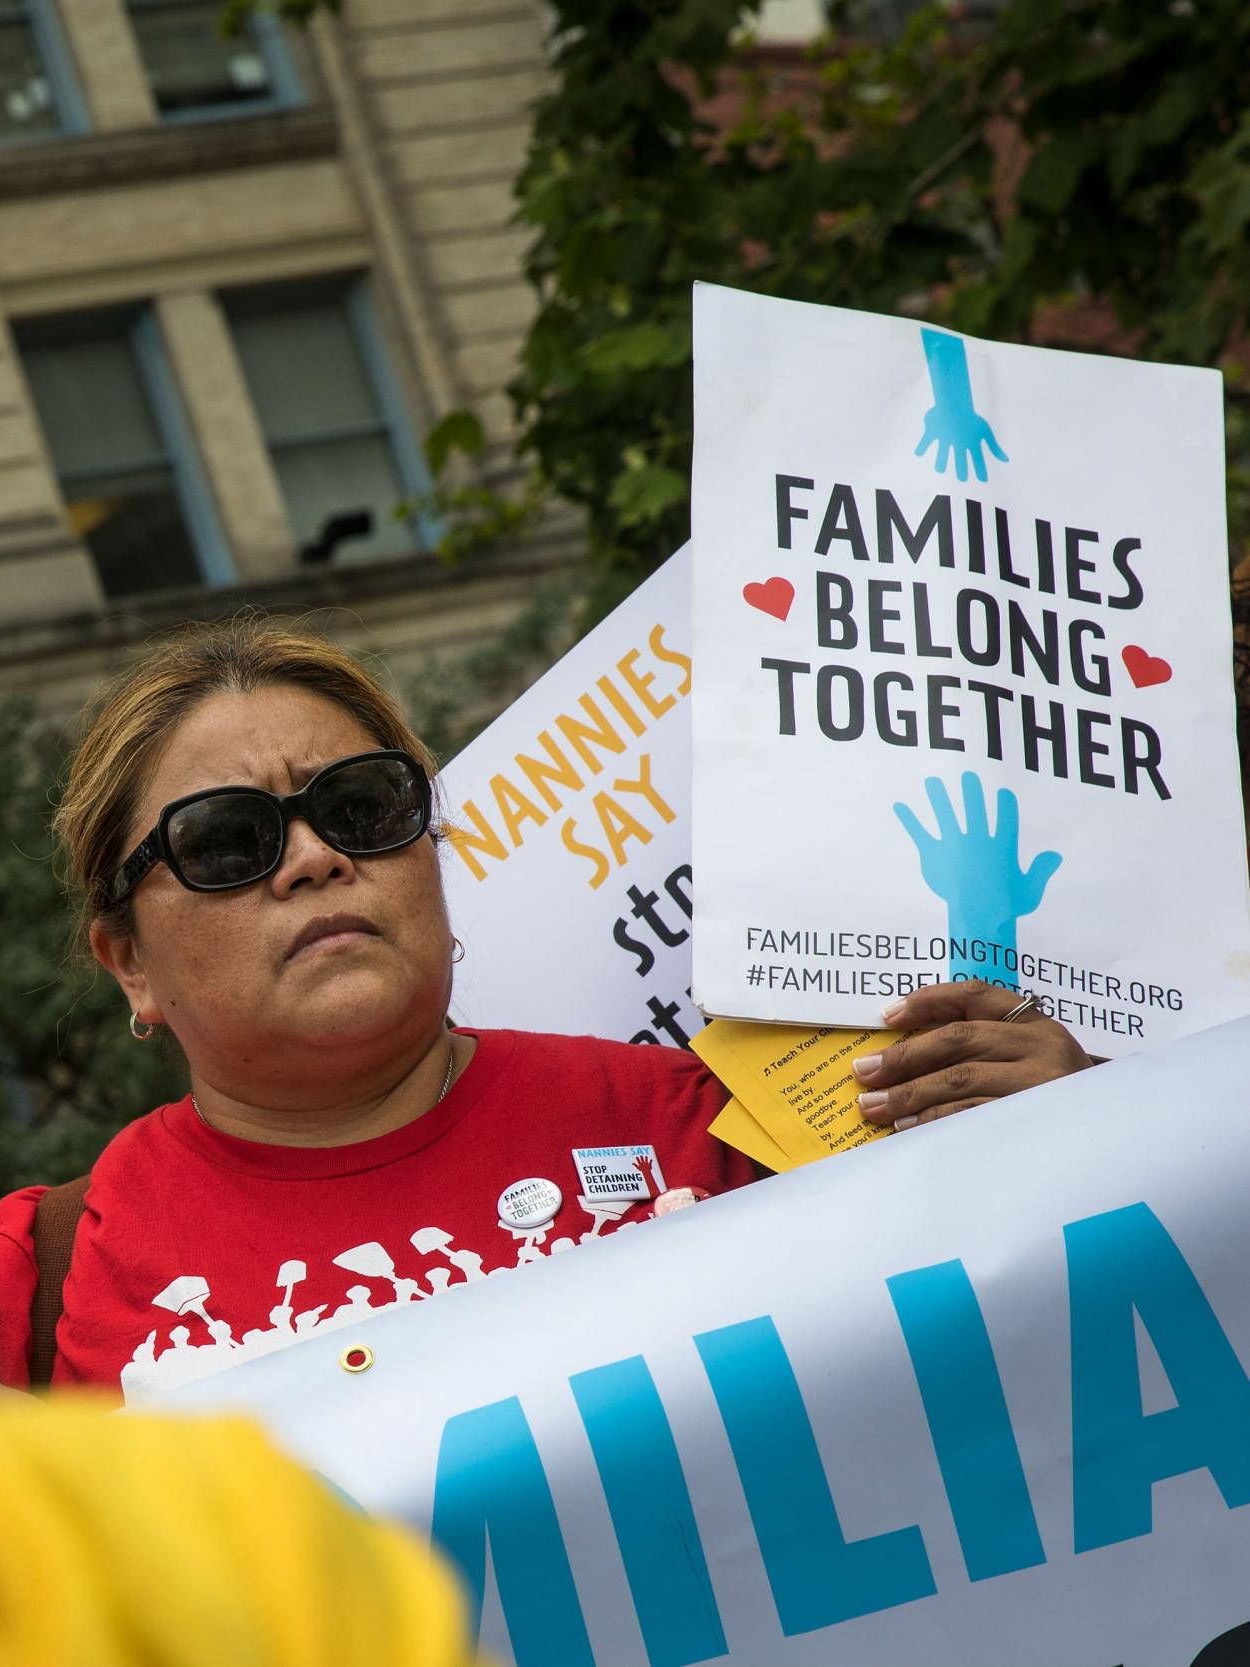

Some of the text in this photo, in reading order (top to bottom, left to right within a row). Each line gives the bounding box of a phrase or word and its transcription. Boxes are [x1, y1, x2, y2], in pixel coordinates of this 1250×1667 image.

[775, 473, 1144, 611] FAMILIES
[816, 570, 1112, 697] BELONG
[761, 657, 1173, 800] TOGETHER
[440, 623, 692, 882] NANNIES
[560, 753, 677, 890] SAY
[746, 927, 1184, 1012] FAMILIESBELONGTOGETHER.ORG
[745, 964, 1145, 1038] #FAMILIESBEGETHER
[770, 1050, 798, 1070] Teach
[797, 1035, 819, 1051] Your
[780, 1083, 801, 1096] You,
[800, 1070, 816, 1084] who
[816, 1061, 830, 1073] are
[830, 1054, 841, 1063] on
[839, 1045, 853, 1056] the
[853, 1031, 871, 1048] road
[788, 1086, 817, 1107] live by.
[798, 1101, 814, 1115] And
[814, 1095, 824, 1104] so
[823, 1074, 854, 1097] become
[812, 1101, 855, 1132] Teach your
[578, 1146, 651, 1158] NANNIES SAY
[830, 1135, 846, 1151] And
[845, 1124, 863, 1139] feed
[583, 1165, 607, 1175] STOP
[586, 1173, 643, 1184] DETAINING
[505, 1181, 548, 1204] FAMILIES
[513, 1190, 548, 1210] BELONG
[589, 1183, 640, 1194] CHILDREN
[511, 1196, 559, 1221] TOGETHER
